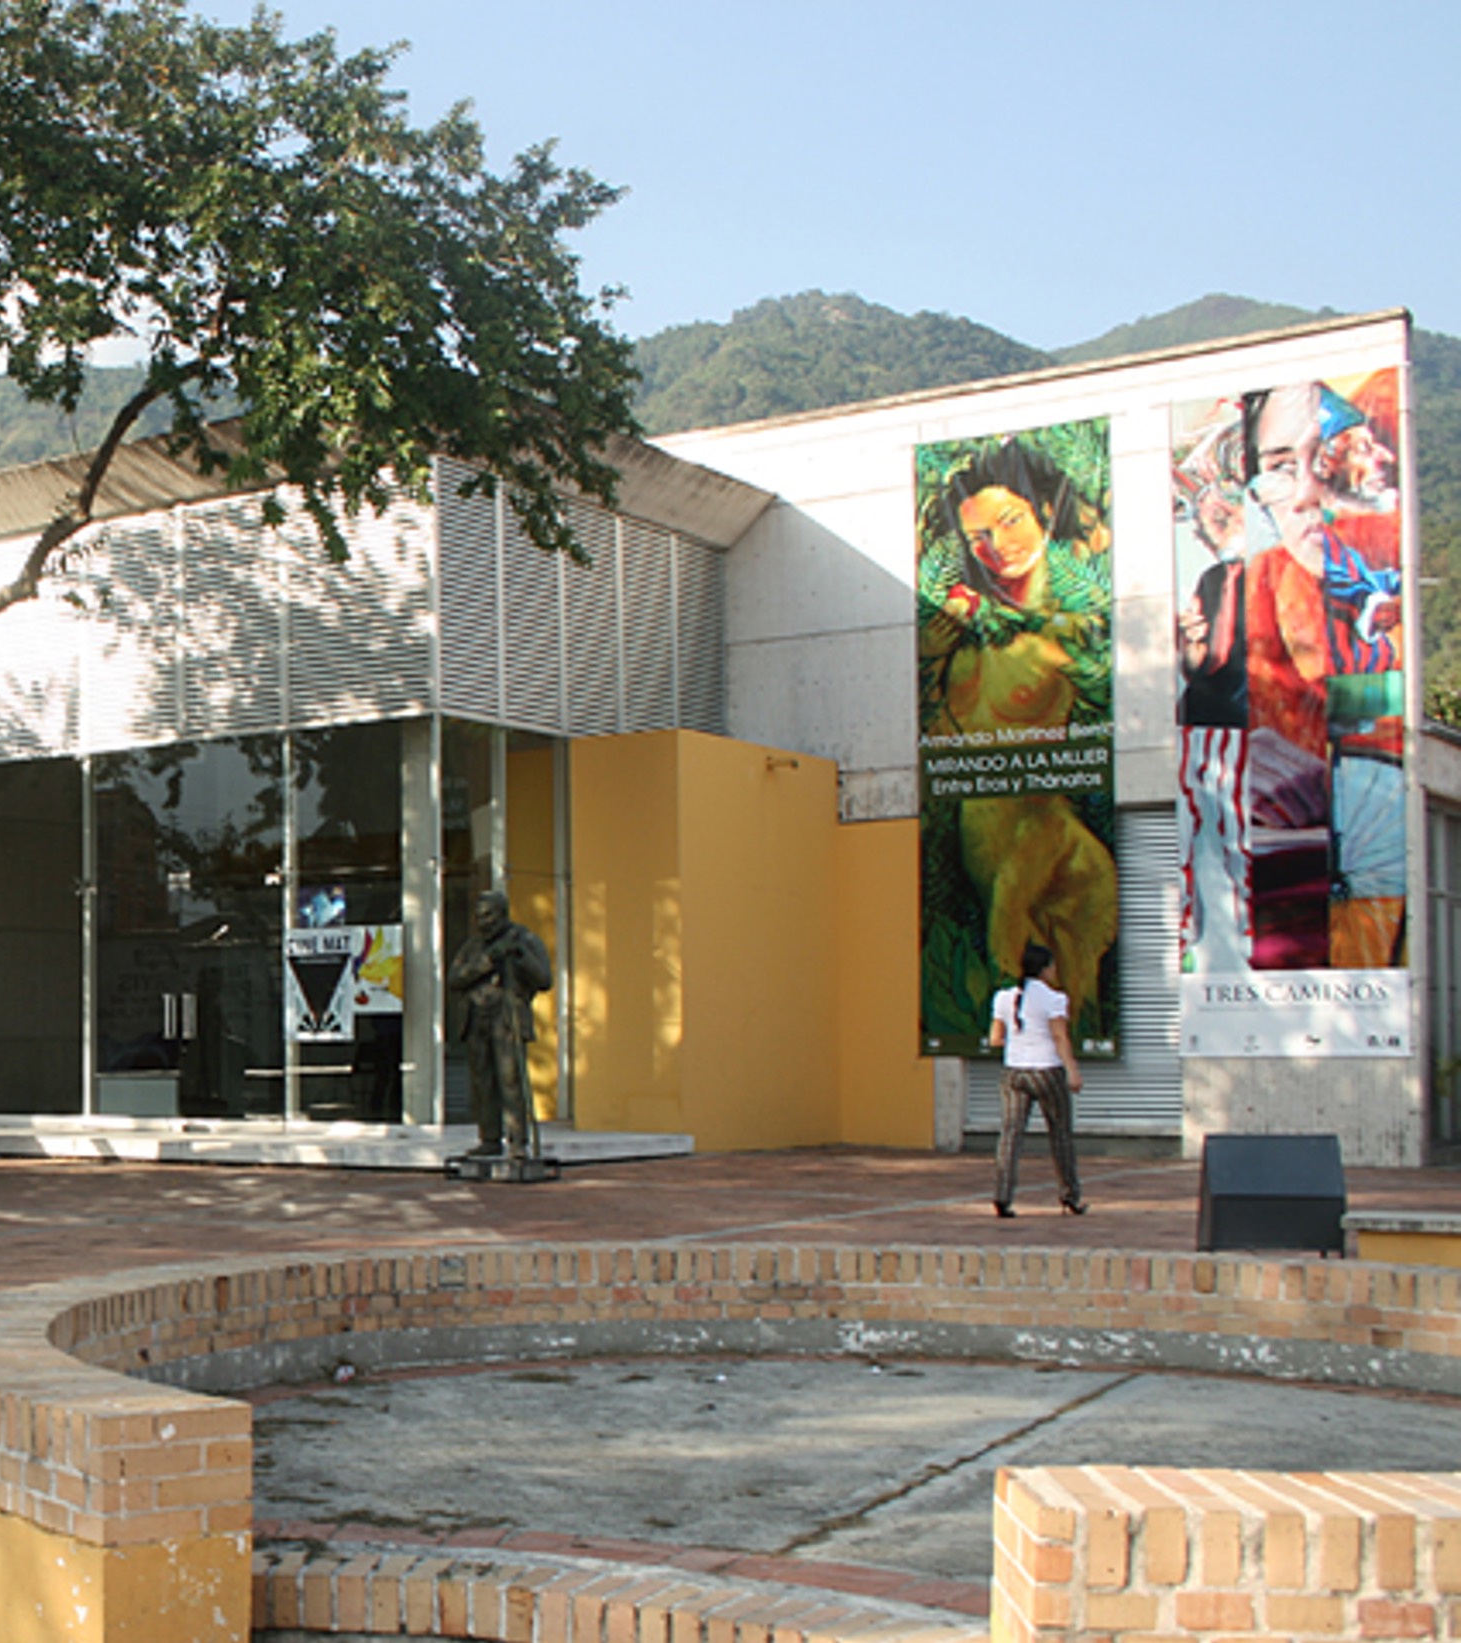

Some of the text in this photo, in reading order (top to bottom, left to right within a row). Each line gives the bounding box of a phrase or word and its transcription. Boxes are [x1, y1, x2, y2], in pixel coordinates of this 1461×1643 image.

[919, 730, 994, 748] Armando
[927, 747, 1108, 773] MIRANDO A LA MUJER
[932, 776, 973, 795] Entre
[976, 775, 1009, 793] Eros
[1010, 777, 1023, 793] y
[1204, 982, 1388, 1003] TRES CAMINOS
